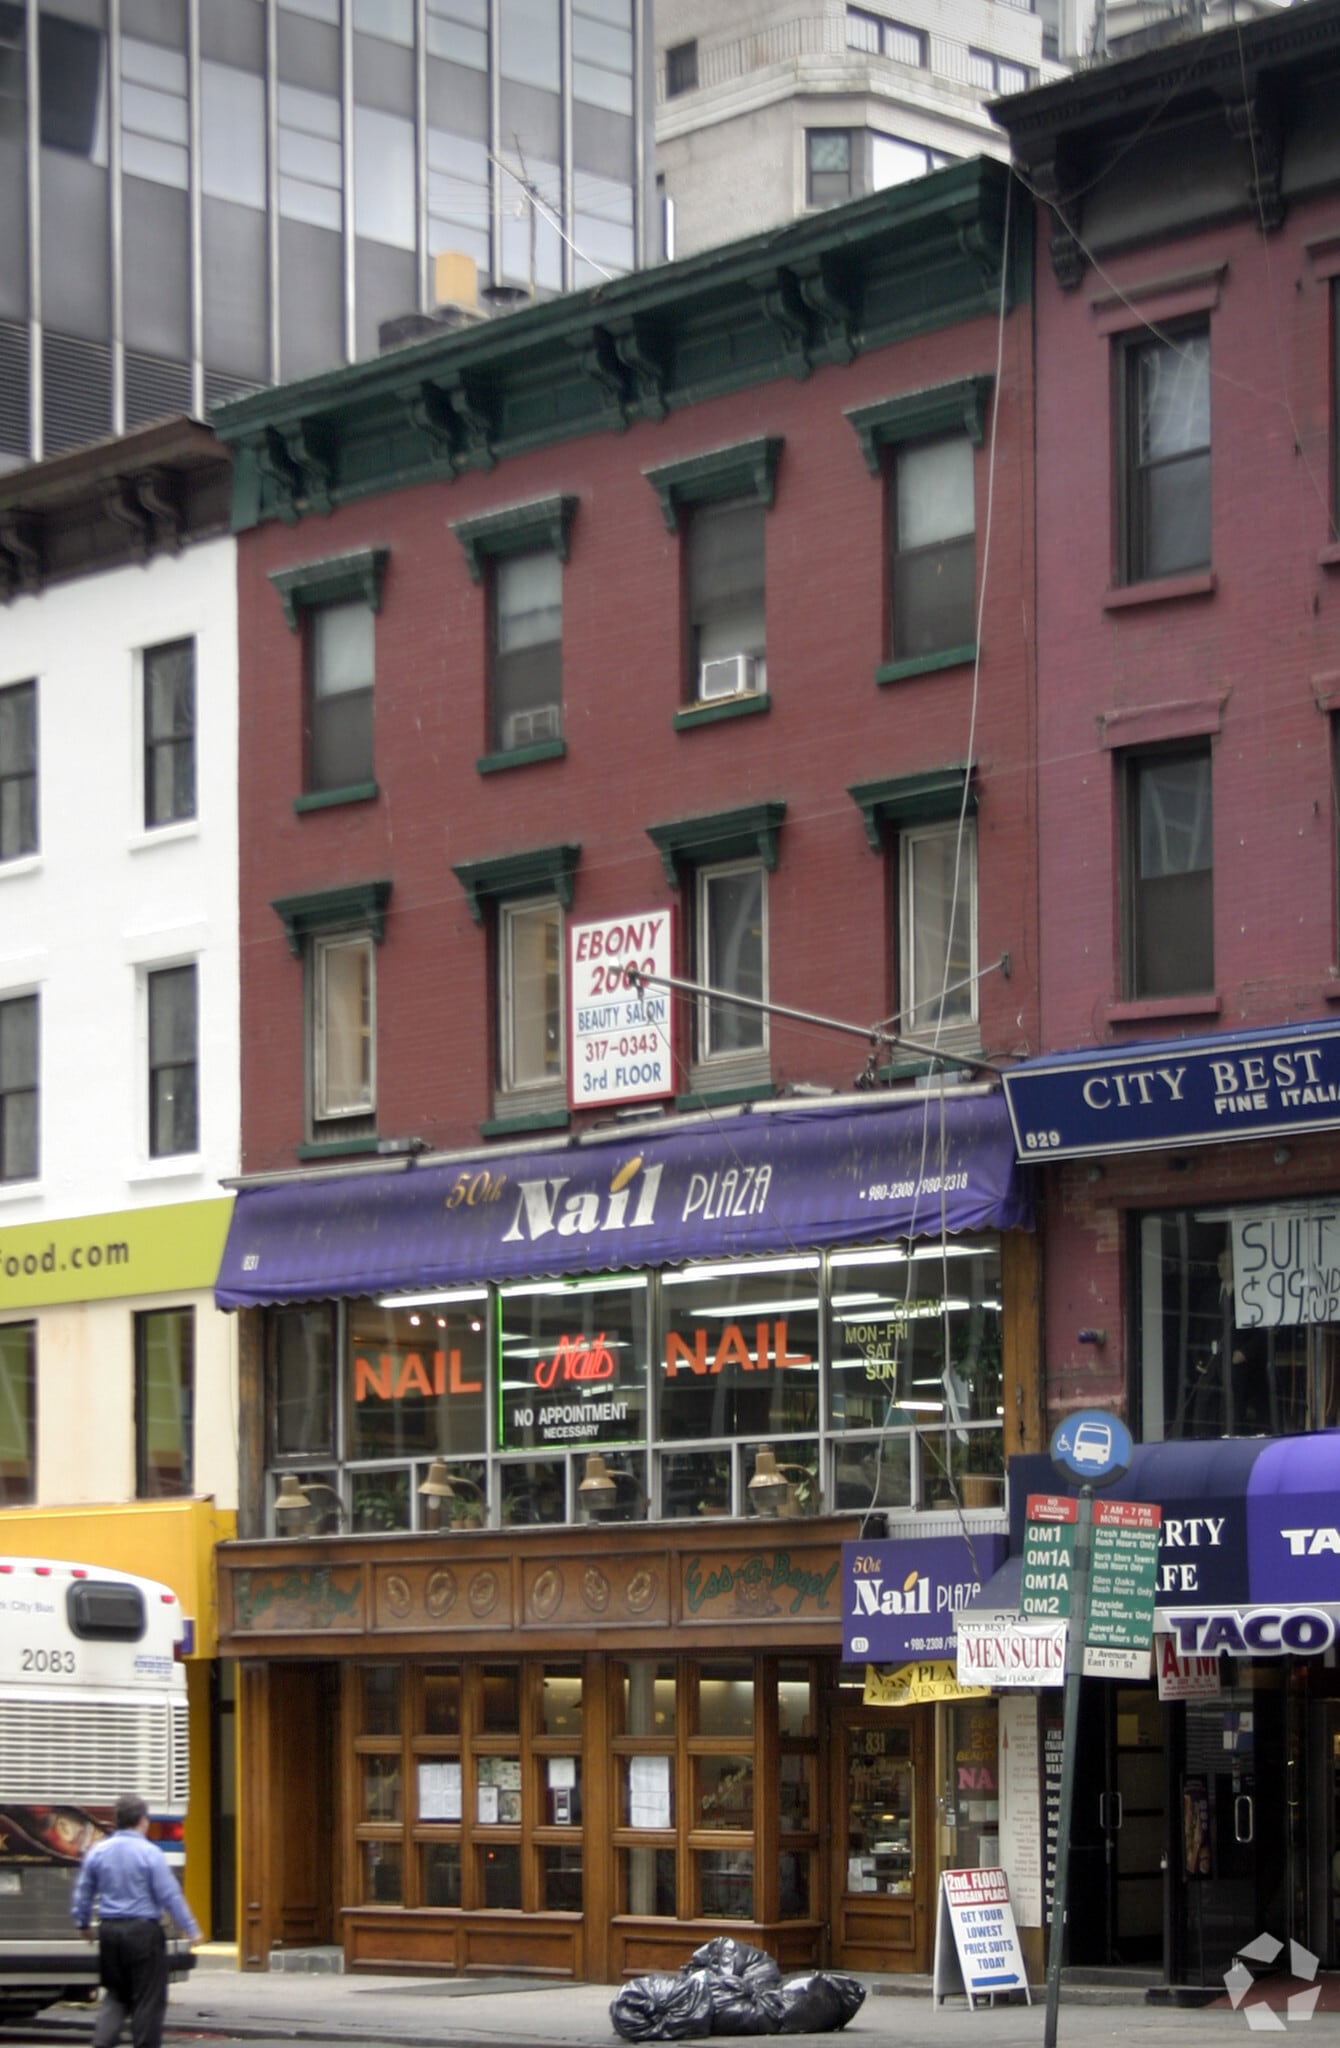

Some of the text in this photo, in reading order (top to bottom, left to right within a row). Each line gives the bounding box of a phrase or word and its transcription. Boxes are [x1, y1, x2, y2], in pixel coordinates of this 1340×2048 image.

[575, 918, 664, 962] EBONY
[590, 957, 655, 996] 2000
[578, 999, 665, 1031] BEAUTY SALON
[585, 1032, 658, 1062] 317-0343
[583, 1062, 661, 1092] 3rd FLOOR
[1083, 1050, 1322, 1109] CITY BEST
[1214, 1084, 1340, 1115] FINE ITALI
[1026, 1130, 1061, 1149] 829
[501, 1156, 664, 1242] Nail
[681, 1164, 772, 1223] PLAZA
[1242, 1215, 1336, 1272] SUIT
[0, 1241, 129, 1277] ood.com
[894, 1299, 939, 1319] OPEN
[665, 1320, 812, 1377] NAIL
[866, 1342, 891, 1360] SAT
[355, 1349, 482, 1403] NAIL
[866, 1361, 896, 1380] SUN
[514, 1402, 628, 1427] NO APPOINTMENT
[543, 1424, 599, 1440] NECESSARY
[1034, 1504, 1070, 1515] STANDING
[1110, 1506, 1123, 1514] AM
[1138, 1507, 1151, 1517] PM
[1100, 1515, 1119, 1524] MON
[1028, 1526, 1061, 1543] QM1
[1096, 1528, 1156, 1540] Fresh Meadows
[1158, 1518, 1225, 1547] RTY
[1095, 1538, 1156, 1550] Rush Hours Only
[1026, 1549, 1070, 1567] QM1A
[1093, 1561, 1144, 1574] Rush Hours Only
[1025, 1573, 1069, 1591] QM1A
[1114, 1577, 1135, 1586] Oaks
[852, 1570, 931, 1617] Nail
[1092, 1584, 1152, 1598] Rush Hours Only
[1023, 1596, 1059, 1614] QM2
[1091, 1599, 1124, 1610] Bayside
[1090, 1608, 1151, 1622] Rush Hours Only
[1088, 1631, 1149, 1646] Rush Hours Only
[1167, 1612, 1331, 1653] TACO
[22, 1649, 76, 1673] 2083
[1088, 1658, 1106, 1666] East
[1098, 1649, 1127, 1659] Avenue
[866, 1732, 886, 1754] 831
[971, 1870, 1006, 1889] FLOOR
[984, 1888, 1009, 1902] PLACE
[960, 1908, 1004, 1923] GET YOUR
[966, 1925, 1003, 1939] LOWEST
[963, 1939, 1014, 1955] PRICE SUITS
[976, 1956, 1006, 1970] TODAY
